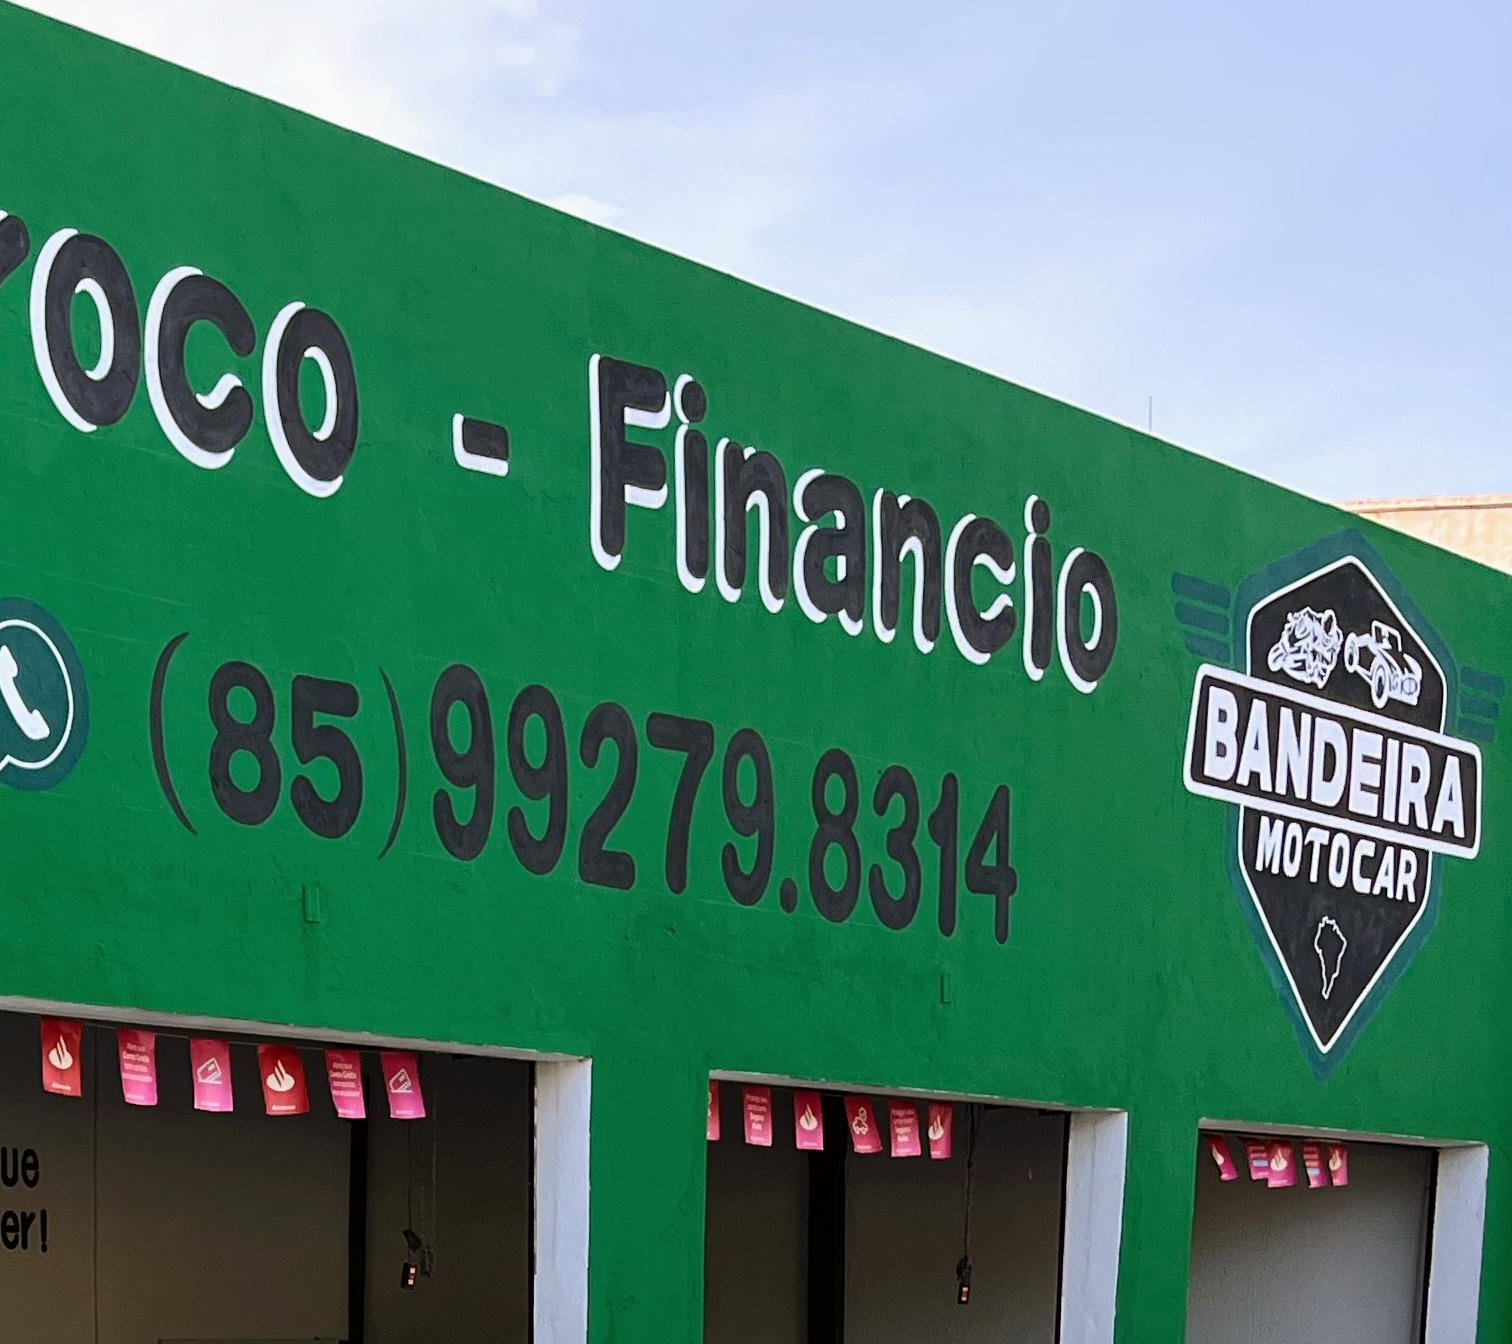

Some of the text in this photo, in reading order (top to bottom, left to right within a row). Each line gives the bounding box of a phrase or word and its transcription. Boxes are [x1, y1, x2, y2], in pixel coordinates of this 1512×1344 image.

[589, 350, 1118, 695] Financio
[1203, 685, 1466, 839] BANDEIRA
[1255, 814, 1417, 903] MOTOCAR
